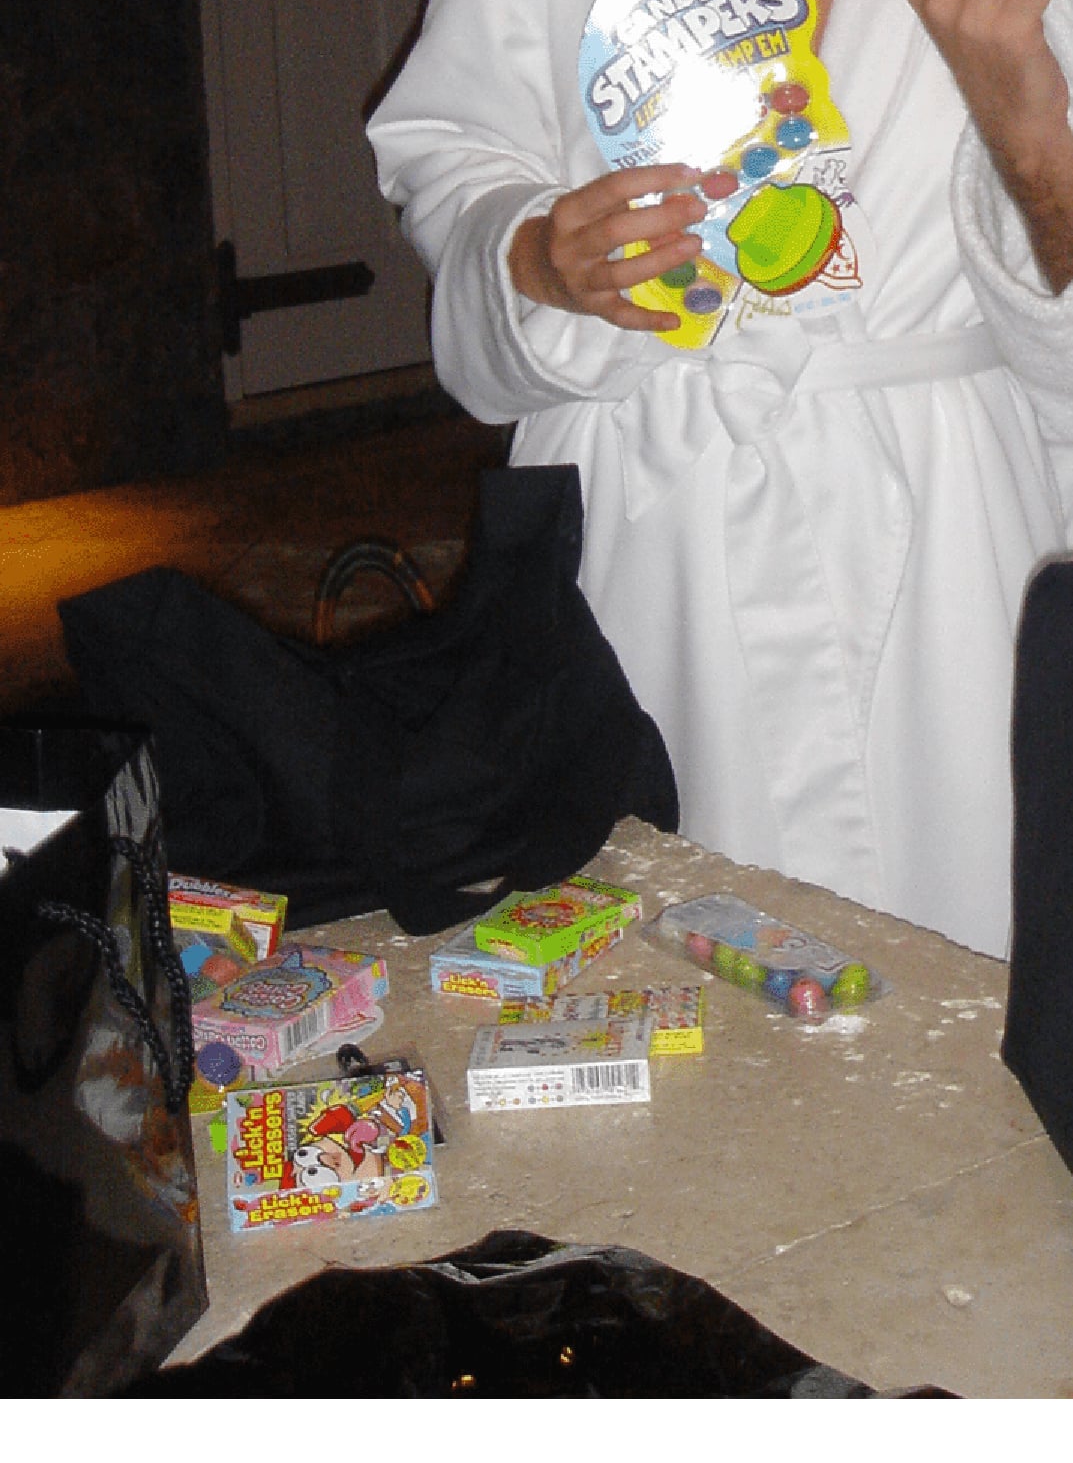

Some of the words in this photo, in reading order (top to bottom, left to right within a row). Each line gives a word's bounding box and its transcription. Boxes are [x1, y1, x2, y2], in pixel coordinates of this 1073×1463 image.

[235, 1106, 264, 1169] Lick'n
[263, 1092, 283, 1180] Erasers
[249, 1201, 336, 1222] Erasers
[261, 1192, 321, 1211] Lick'n
